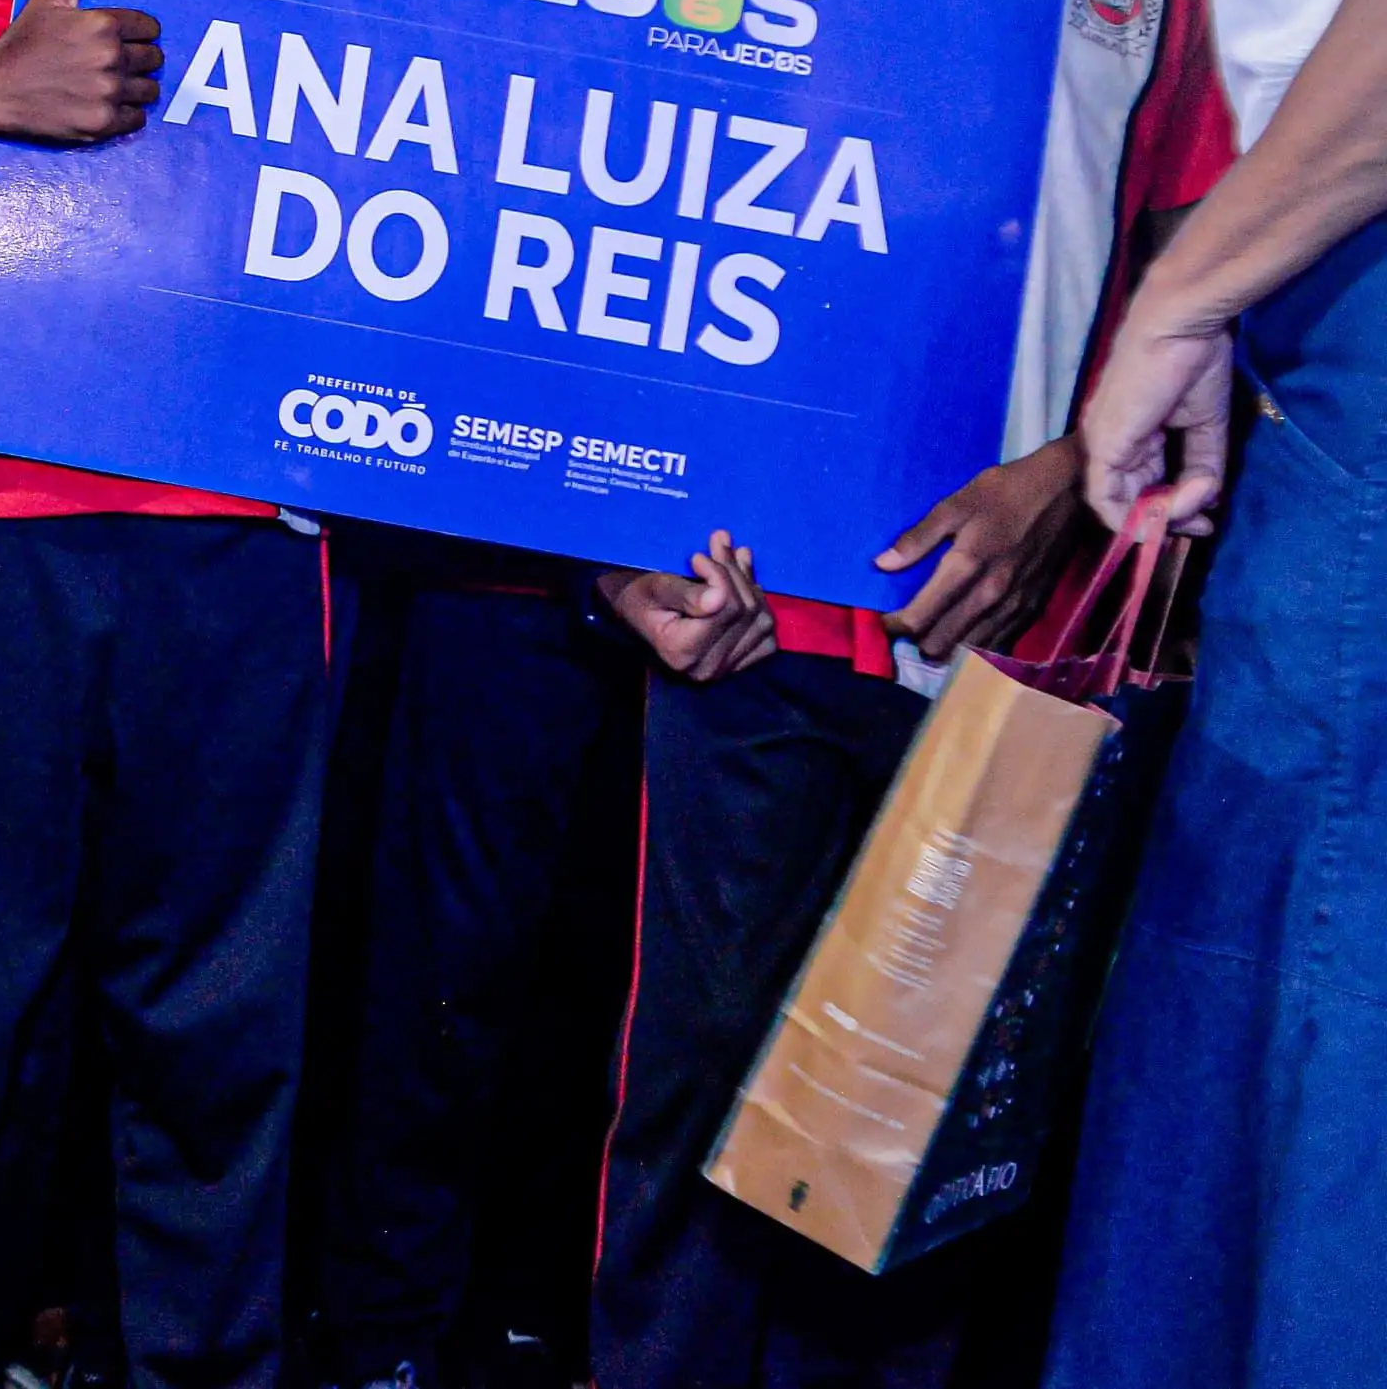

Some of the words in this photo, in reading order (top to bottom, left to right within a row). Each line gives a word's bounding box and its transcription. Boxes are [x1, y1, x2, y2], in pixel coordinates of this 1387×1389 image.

[647, 26, 813, 76] PARAJECOS
[163, 19, 458, 175] ANA
[494, 74, 890, 255] LUIZA
[244, 165, 449, 302] DO
[483, 209, 787, 366] REIS
[307, 374, 393, 398] PREFEITURA
[398, 390, 417, 402] DE
[278, 389, 433, 457] CODÓ
[452, 414, 564, 452] SEMESP
[570, 435, 687, 476] SEMECTI
[297, 444, 362, 463] TRABALHO
[365, 456, 372, 465] E
[377, 458, 426, 475] FUTURO
